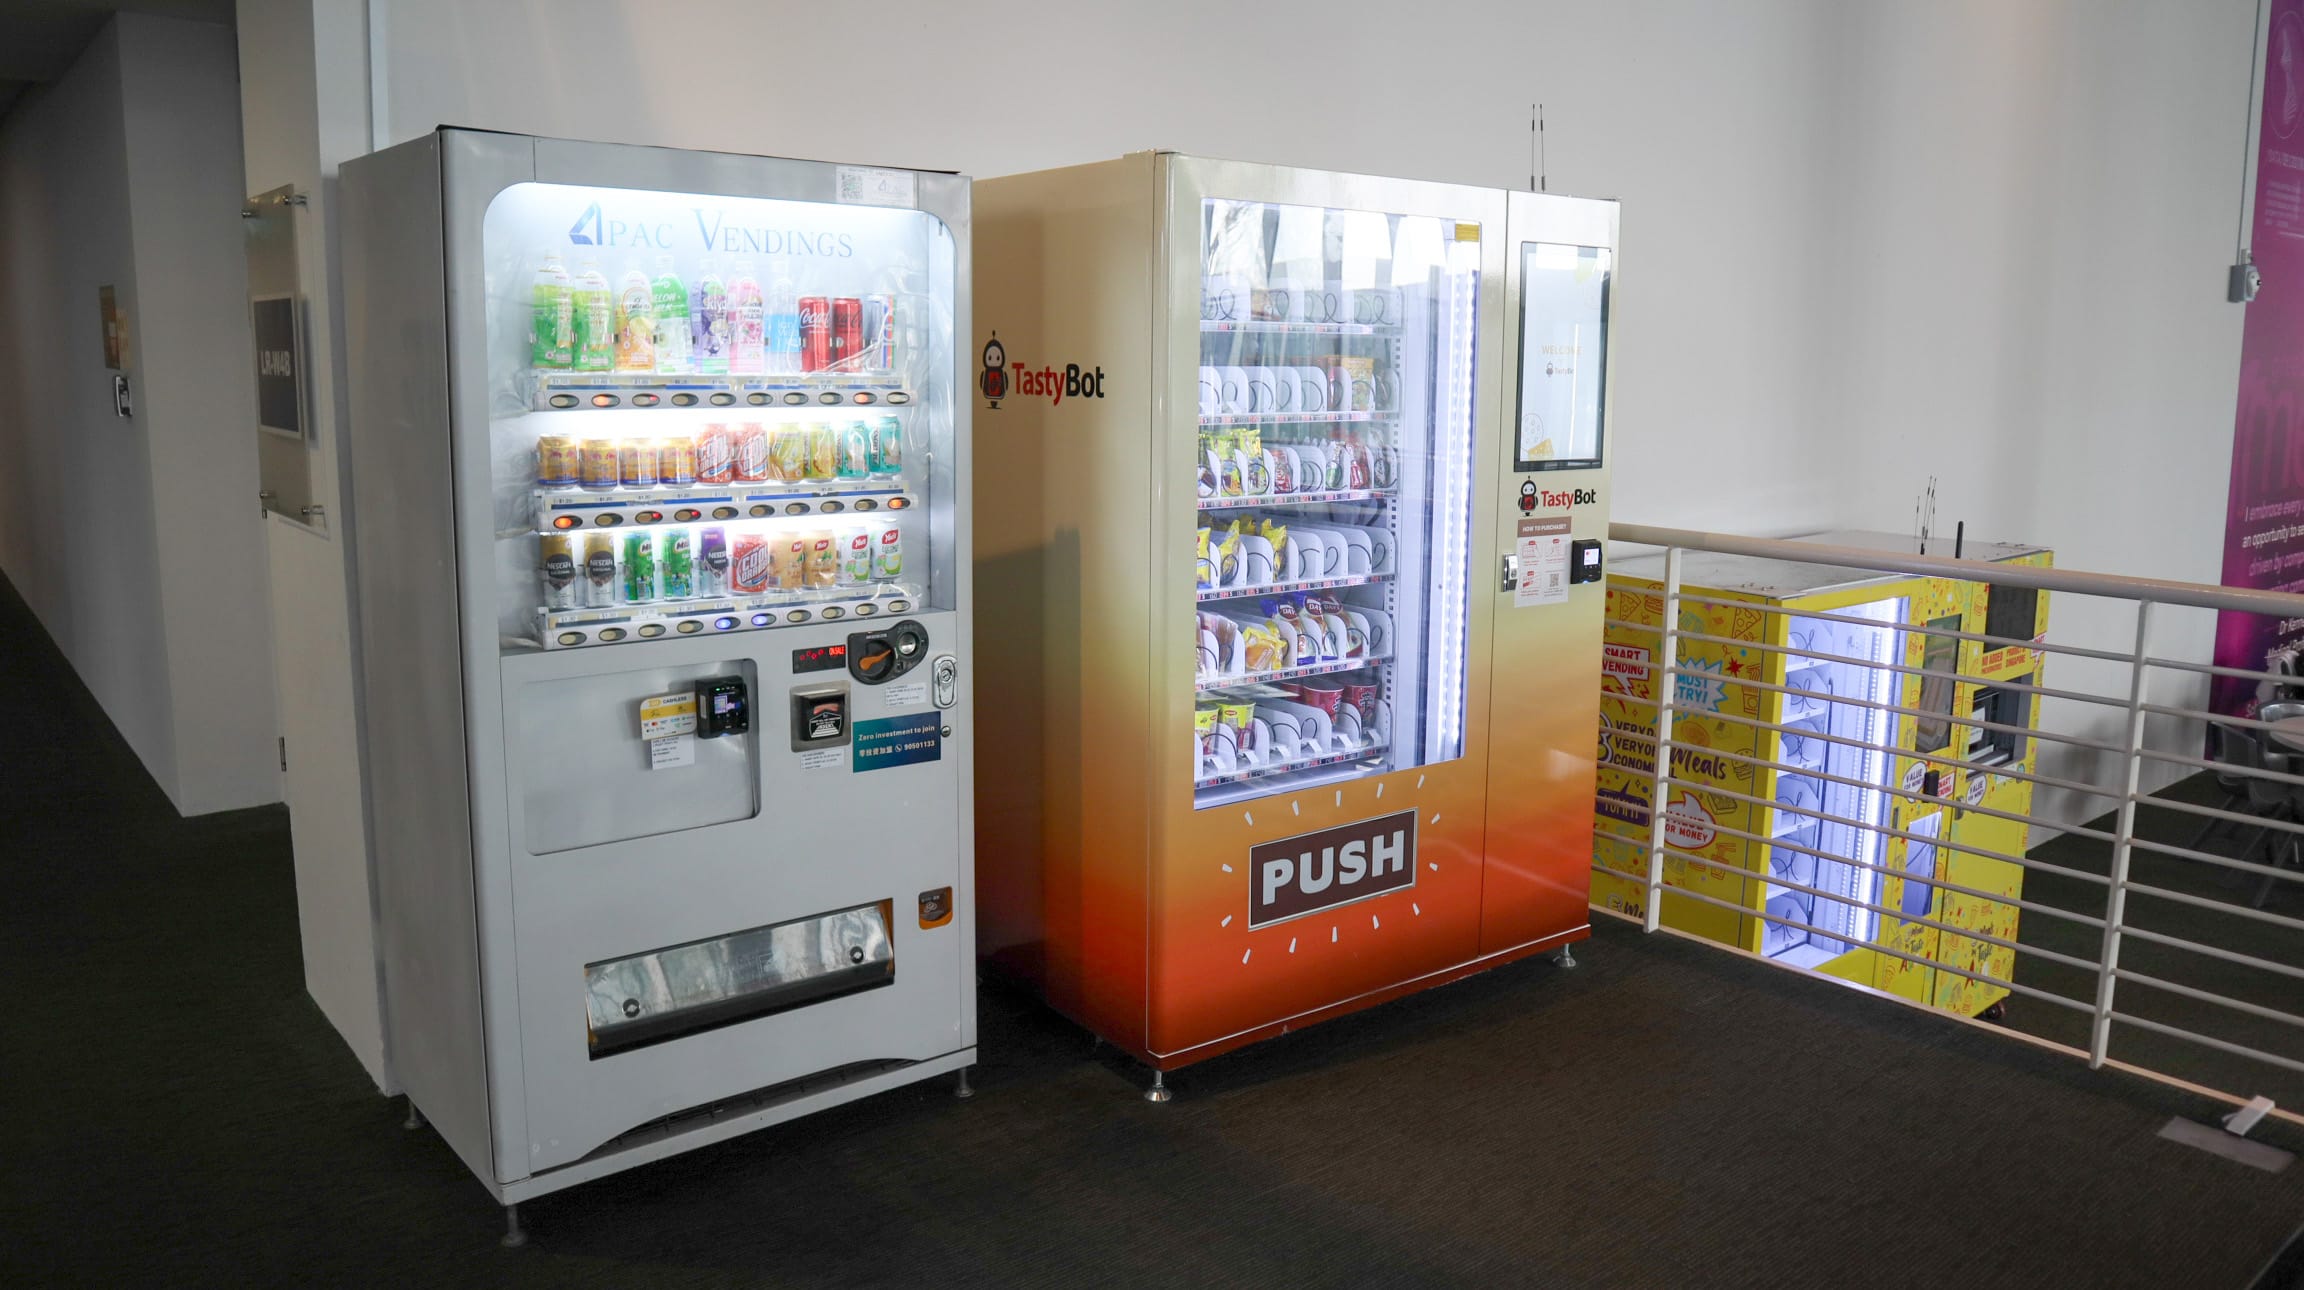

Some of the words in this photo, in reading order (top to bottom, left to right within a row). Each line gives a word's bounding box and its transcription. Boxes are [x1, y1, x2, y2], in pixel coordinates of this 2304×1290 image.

[1011, 362, 1105, 406] TastyBot
[1540, 488, 1596, 510] TastyBot
[2242, 535, 2252, 549] an
[2252, 525, 2289, 550] opportunity
[2289, 523, 2297, 538] to
[1605, 647, 1641, 661] SMART
[1602, 660, 1644, 676] VENDING
[1677, 673, 1709, 688] MUST
[1680, 686, 1709, 704] TRY!
[858, 733, 875, 742] Zero
[875, 728, 913, 739] investment
[914, 726, 922, 734] to
[922, 724, 935, 734] join
[1679, 827, 1708, 842] MONEY
[1262, 829, 1405, 906] PUSH
